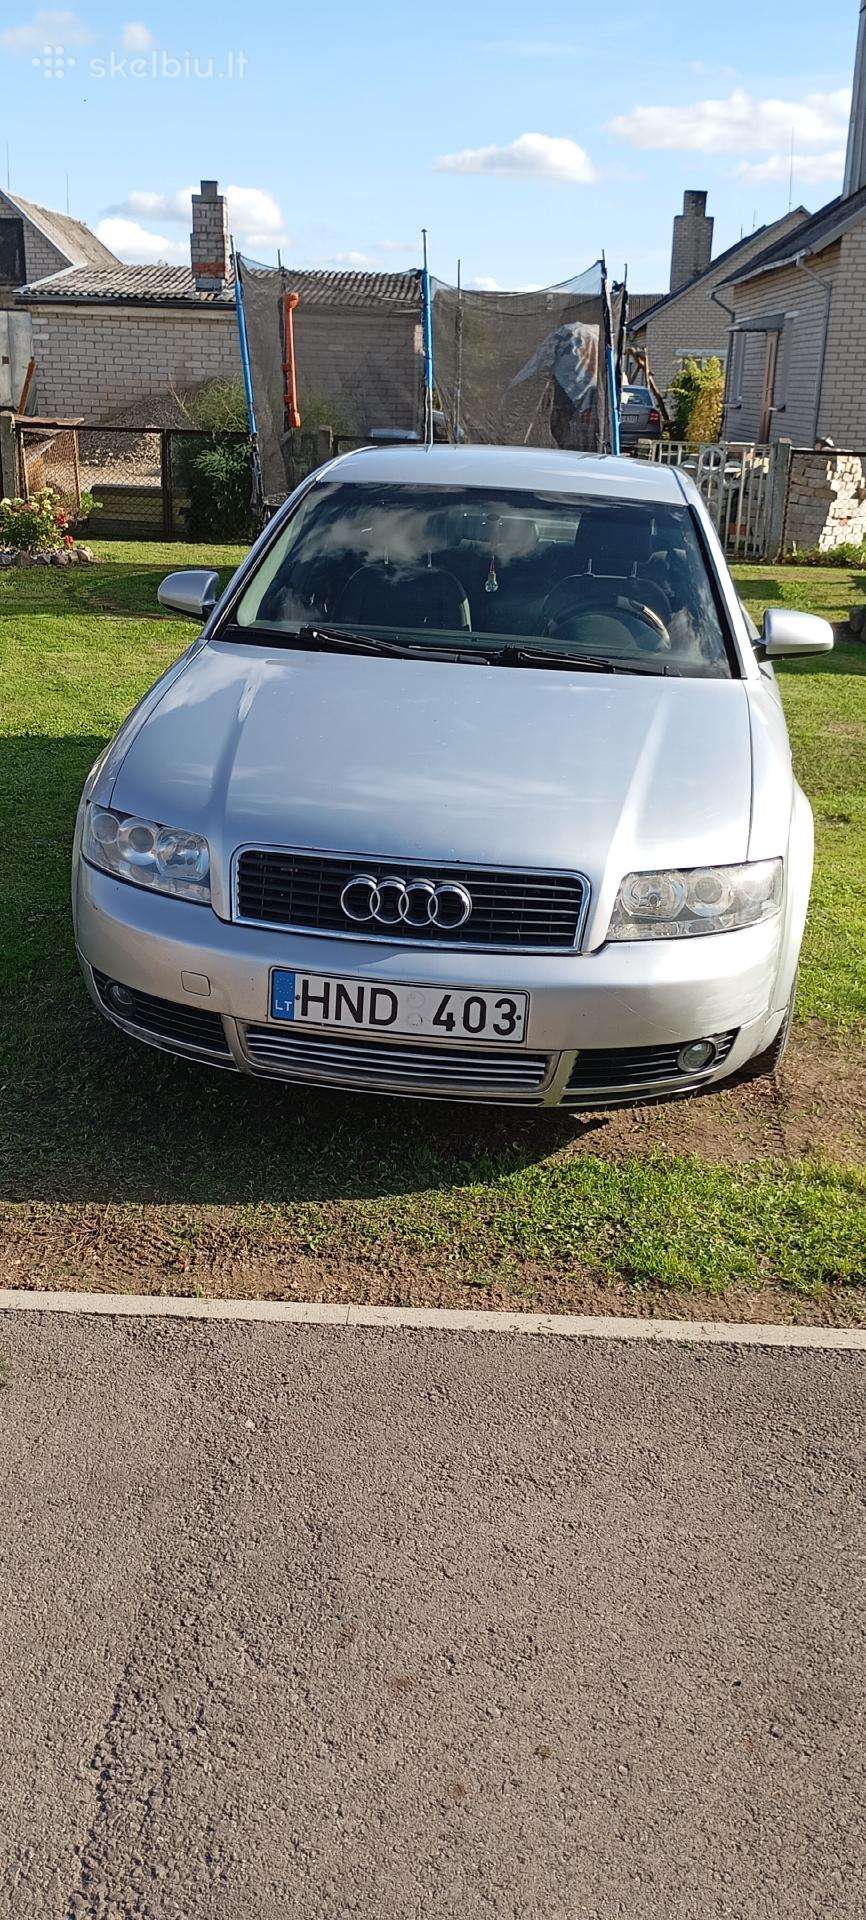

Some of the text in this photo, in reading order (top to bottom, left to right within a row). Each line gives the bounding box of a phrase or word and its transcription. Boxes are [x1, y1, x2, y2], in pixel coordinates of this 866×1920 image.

[275, 999, 292, 1012] LT
[300, 979, 517, 1036] HND 403
